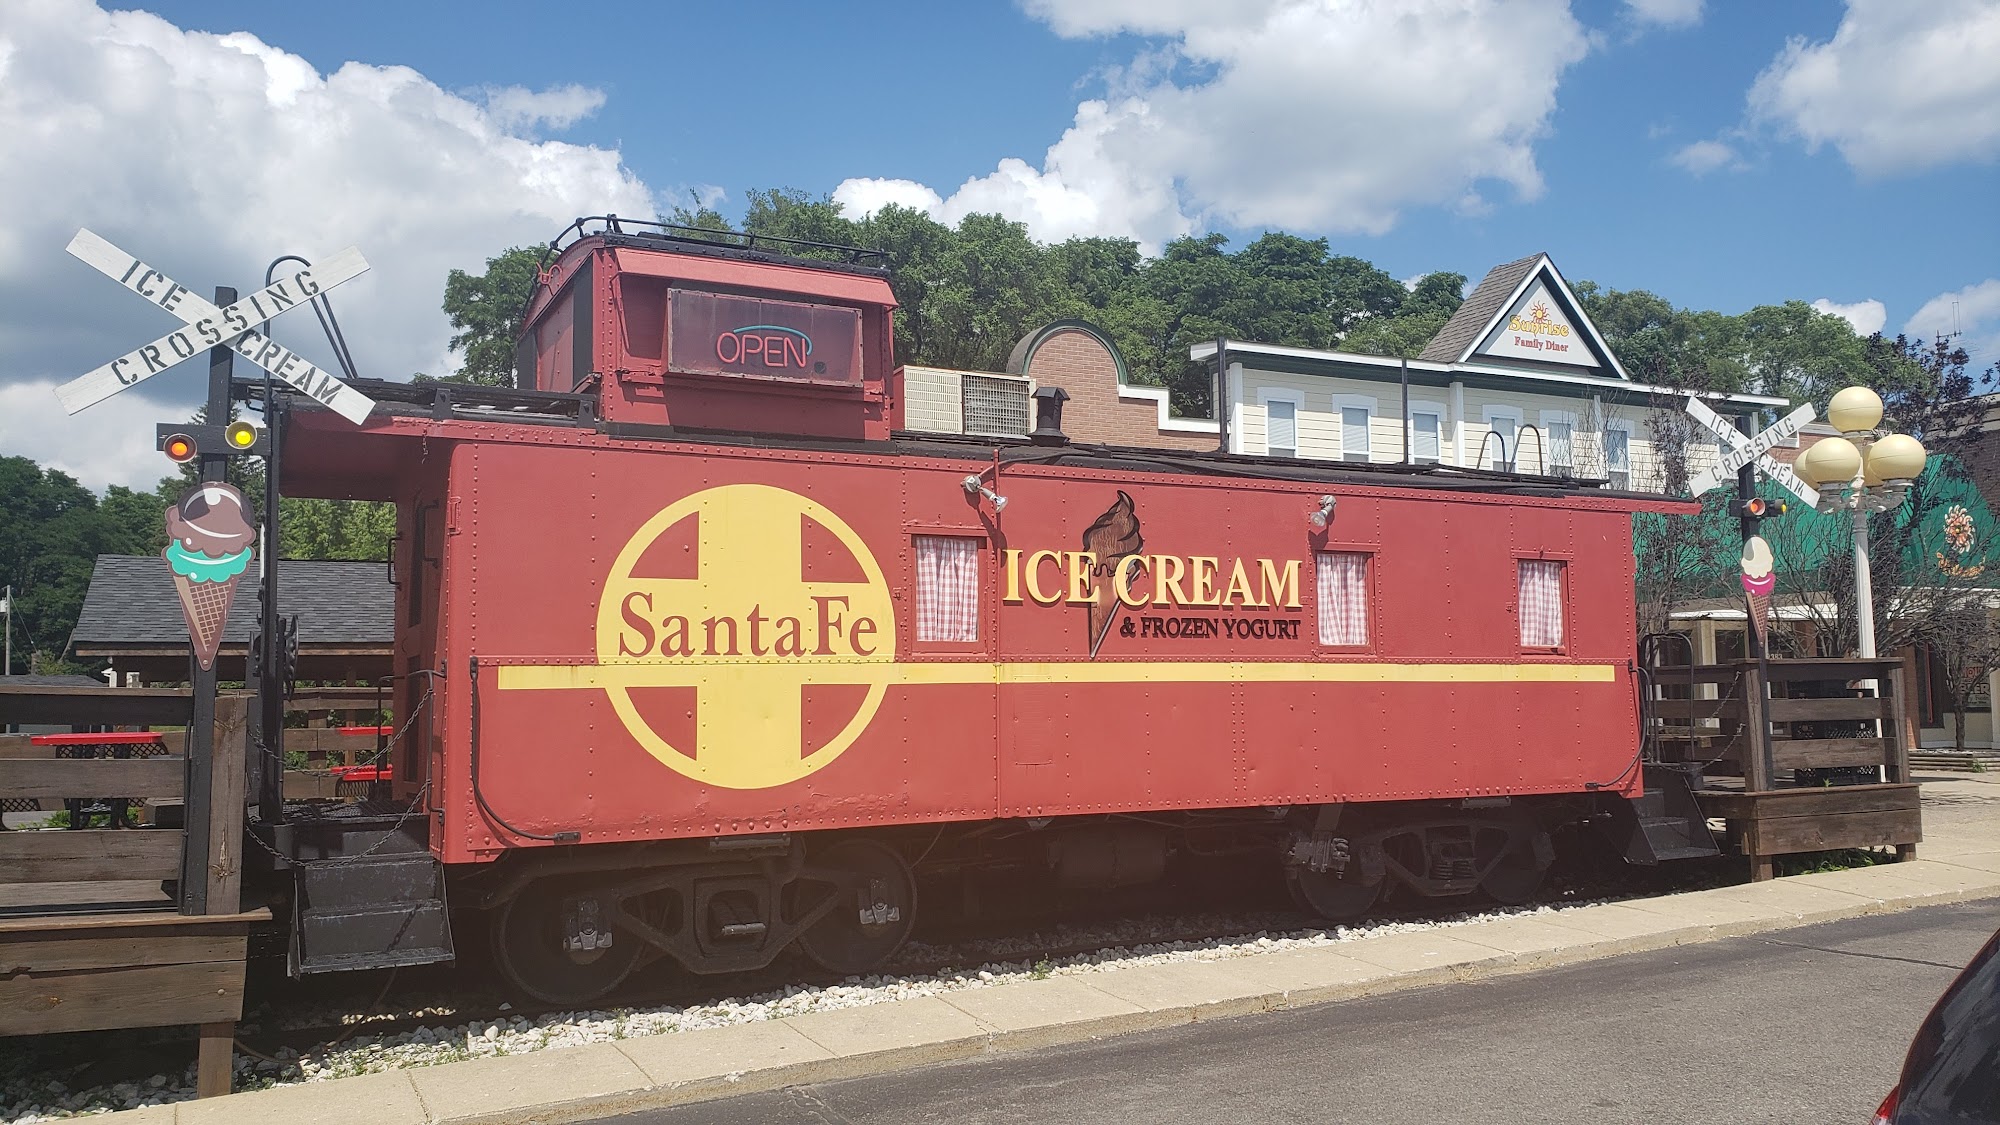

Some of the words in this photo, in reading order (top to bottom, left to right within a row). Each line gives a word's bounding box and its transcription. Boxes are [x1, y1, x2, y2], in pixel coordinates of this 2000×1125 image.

[111, 270, 319, 386] CROSSING
[120, 259, 188, 312] ICE
[234, 329, 344, 405] CREAM
[716, 332, 807, 368] OPEN
[1509, 314, 1570, 337] Sunrise
[1514, 336, 1544, 351] Family
[1545, 340, 1569, 352] Diner
[1710, 414, 1737, 444] ICE
[1758, 453, 1805, 497] CREAM
[1711, 417, 1795, 482] CROSSING
[1001, 549, 1101, 604] ICE
[1114, 554, 1304, 609] CREAM
[1119, 616, 1137, 639] &
[1140, 616, 1219, 640] FROZEN
[1222, 618, 1302, 640] YOGURT
